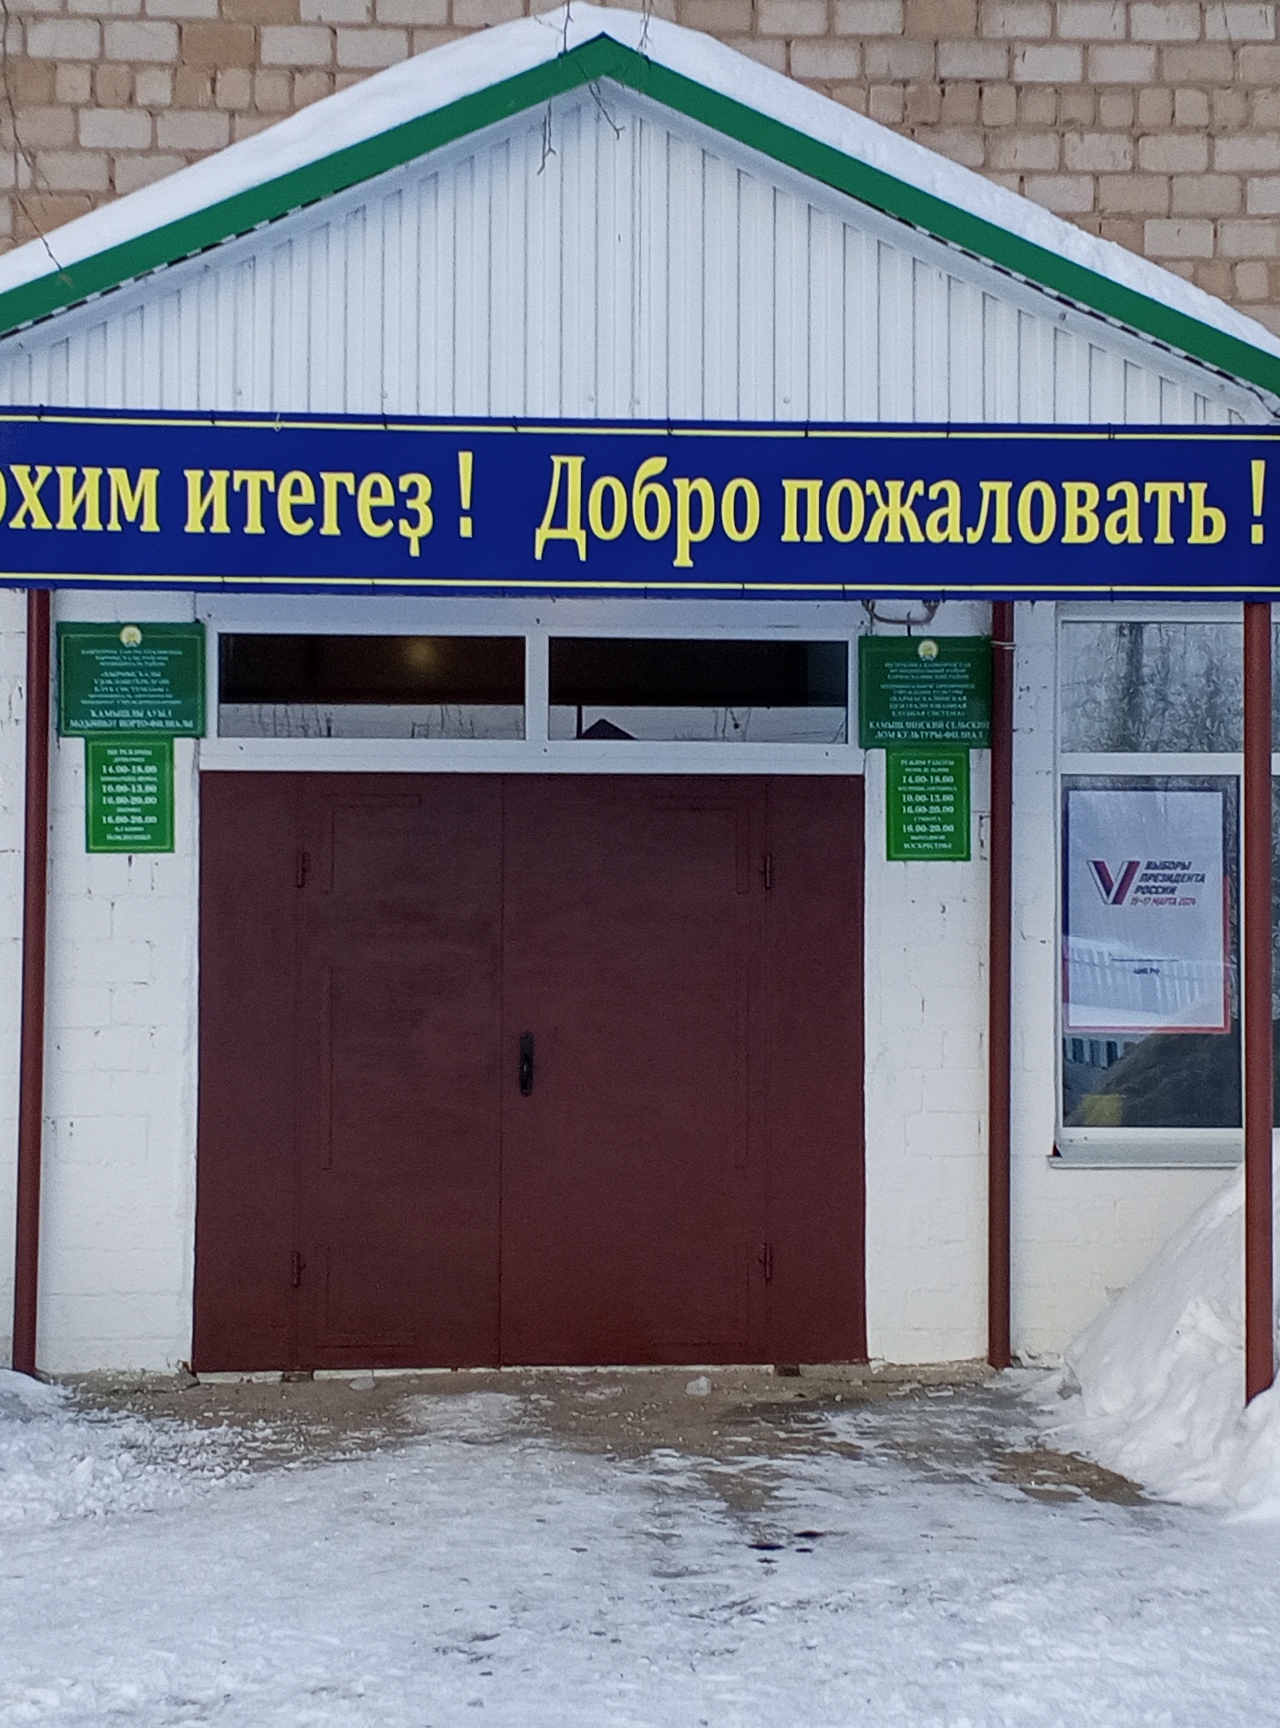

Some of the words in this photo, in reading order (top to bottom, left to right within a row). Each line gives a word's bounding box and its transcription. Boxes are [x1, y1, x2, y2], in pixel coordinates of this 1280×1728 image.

[183, 467, 434, 557] итегеҙ
[533, 454, 761, 568] Добро
[780, 475, 1228, 546] пожаловать
[1144, 861, 1192, 871] ВЫБОРЫ
[1138, 873, 1206, 883] ПРЕЗИДЕНТА
[1133, 885, 1178, 895] РОССИИ
